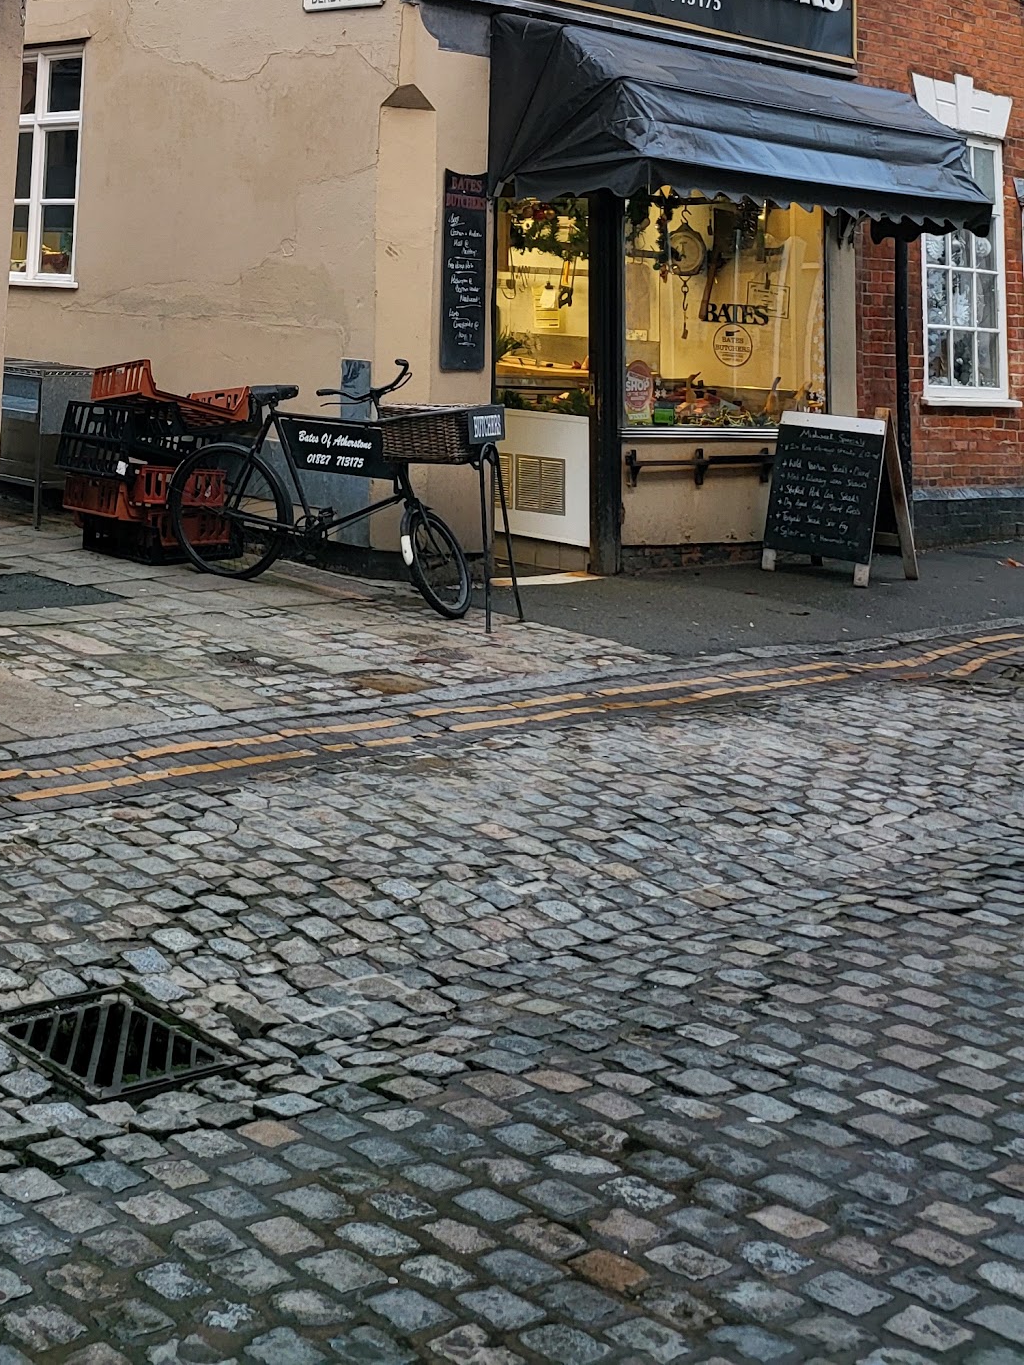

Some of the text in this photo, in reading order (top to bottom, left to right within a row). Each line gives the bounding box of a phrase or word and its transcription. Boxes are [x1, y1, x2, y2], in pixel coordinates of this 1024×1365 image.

[451, 176, 483, 194] BATES
[445, 192, 487, 211] BUTCHERS
[701, 303, 769, 327] BATES
[715, 344, 751, 353] BUTCHERS
[721, 336, 744, 344] BATES
[625, 379, 650, 392] SHOP
[473, 414, 502, 438] BUTCHERS
[298, 430, 373, 450] Bates Of Atherstone
[306, 453, 365, 468] 01827 713175
